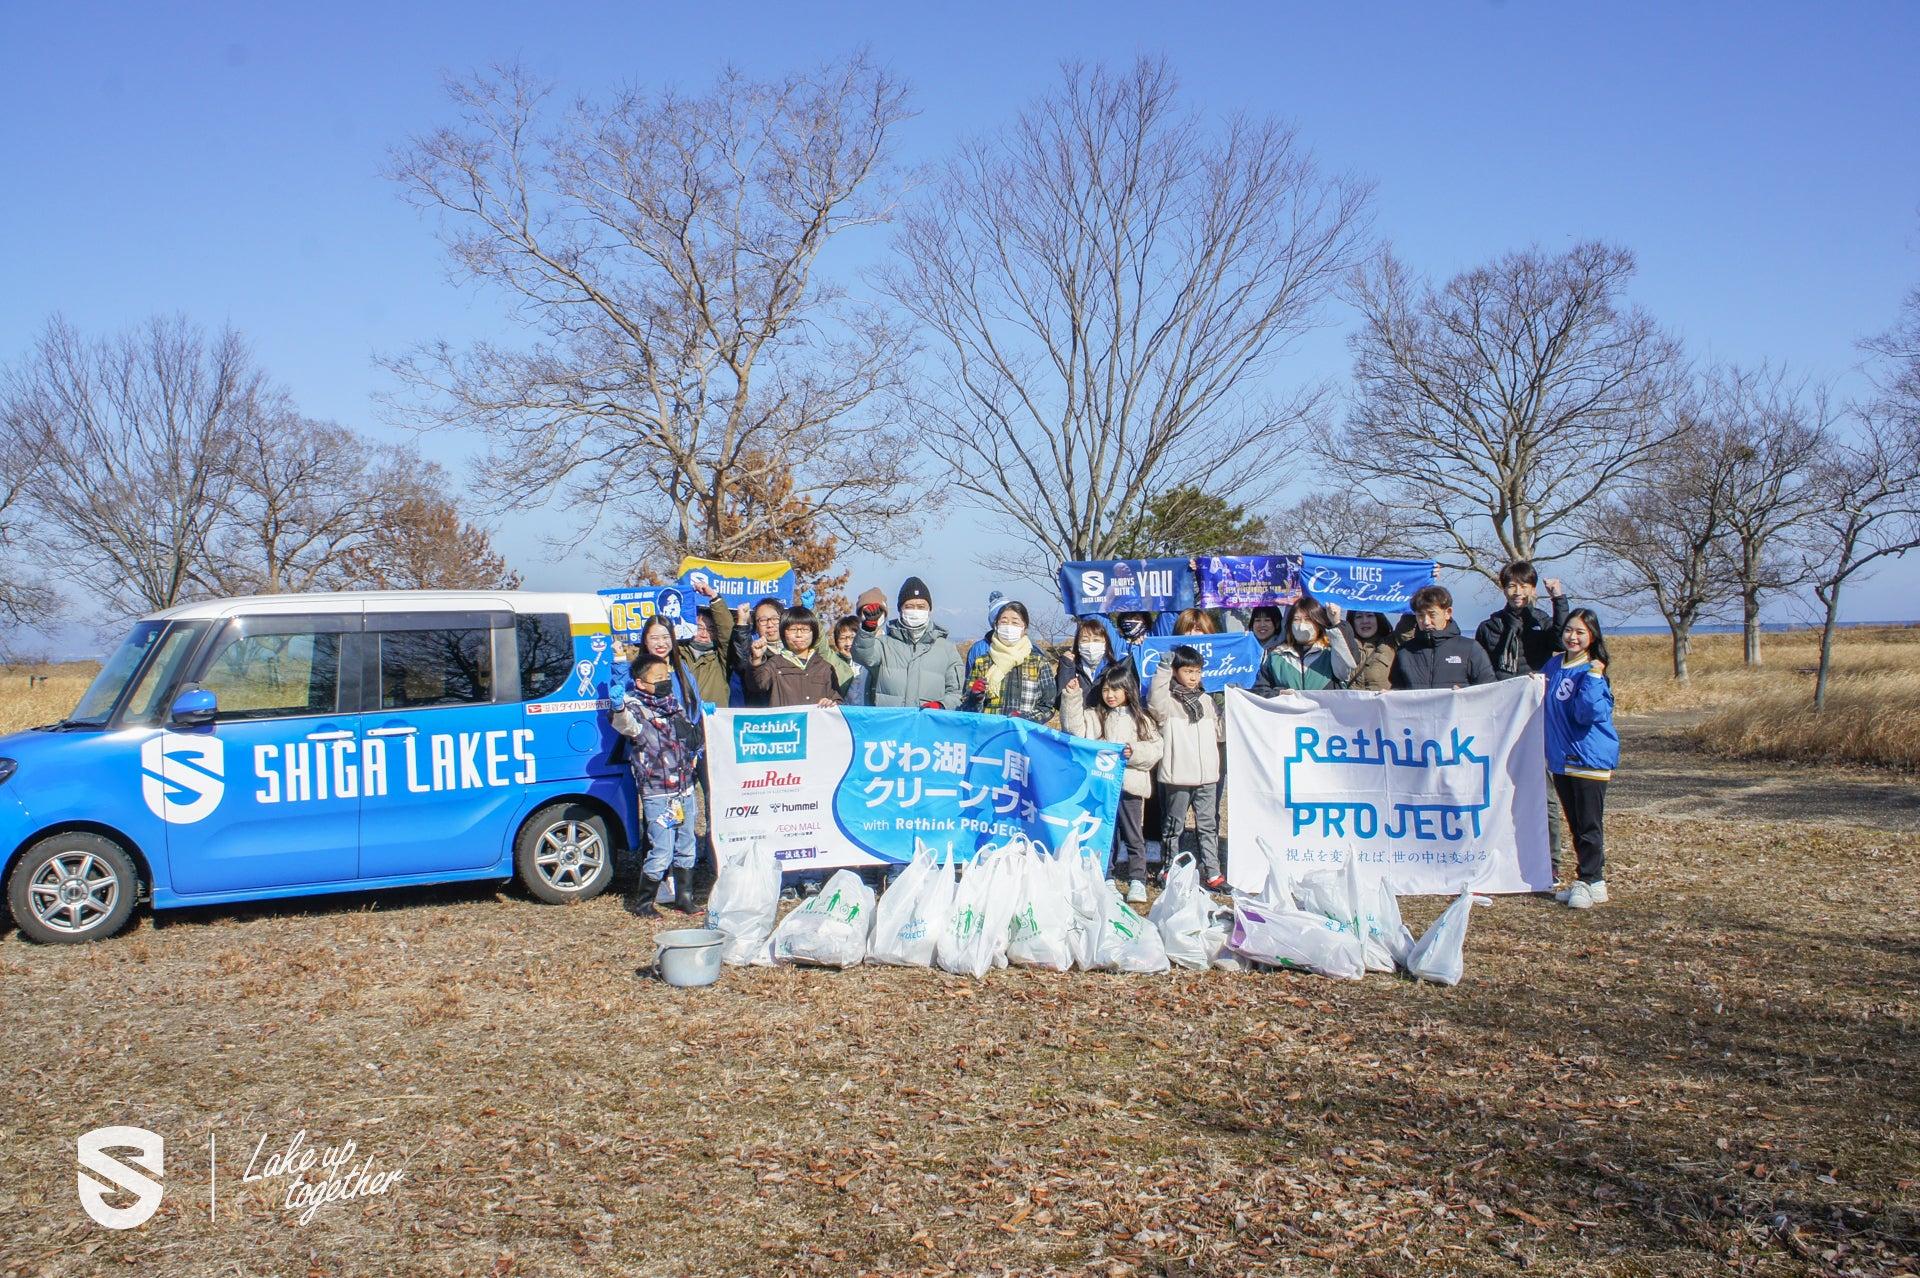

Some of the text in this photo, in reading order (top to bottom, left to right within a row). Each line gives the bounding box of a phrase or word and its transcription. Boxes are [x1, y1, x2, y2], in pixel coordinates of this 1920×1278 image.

[1110, 577, 1135, 586] ALWAYS
[1350, 565, 1382, 582] LAKES
[713, 579, 779, 595] SHIGA LAKES
[1114, 588, 1131, 596] WITH
[1136, 570, 1173, 597] YOU
[1308, 566, 1412, 602] Cheer Leader
[1187, 643, 1213, 658] KES
[1202, 660, 1254, 678] eaders
[742, 720, 799, 733] Rethink
[741, 743, 798, 756] PROJECT
[1295, 726, 1476, 767] Rethink
[255, 728, 537, 804] SHIGA LAKES
[864, 731, 1030, 788] びわ湖一周
[741, 770, 802, 789] muRata
[782, 800, 818, 812] hummel
[863, 767, 1102, 840] クリーンウォーク
[799, 822, 821, 830] MALL
[863, 820, 890, 831] with
[896, 818, 955, 831] Rethink
[1292, 802, 1482, 841] PROJECT
[1286, 848, 1488, 865] 視点を変れば、世の中は変わる
